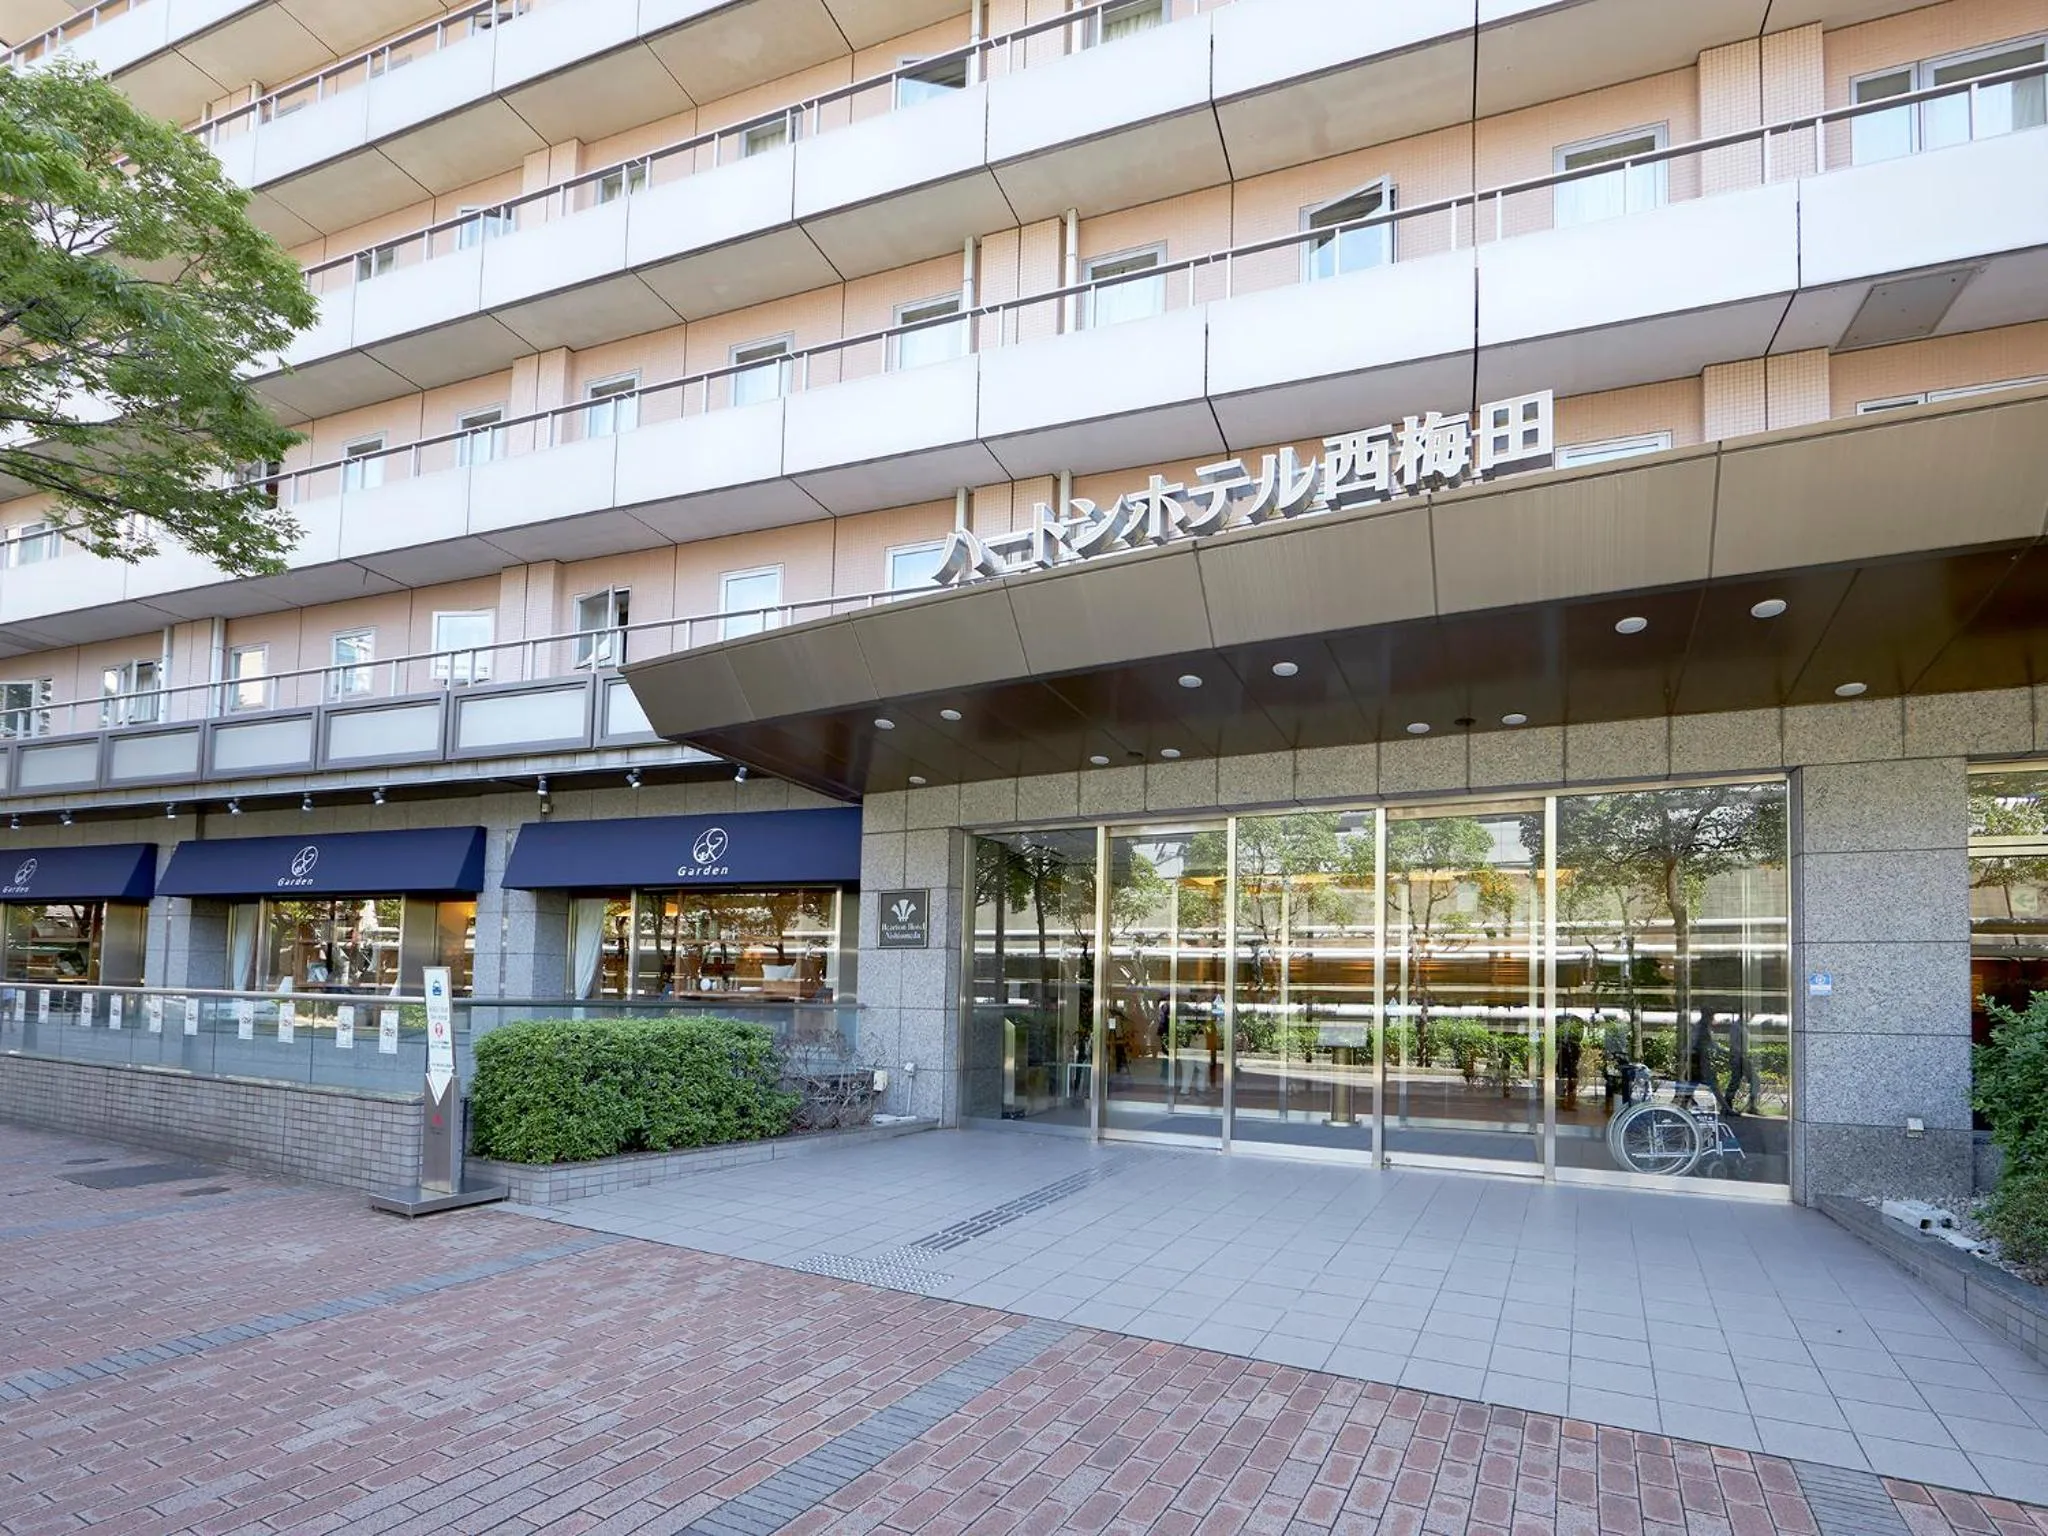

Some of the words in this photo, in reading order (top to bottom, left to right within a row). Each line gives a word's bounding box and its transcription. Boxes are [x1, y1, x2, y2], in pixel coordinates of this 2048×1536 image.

[931, 389, 1555, 585] ハートンホテル西梅田
[677, 865, 729, 876] Garden
[277, 876, 314, 887] Garden
